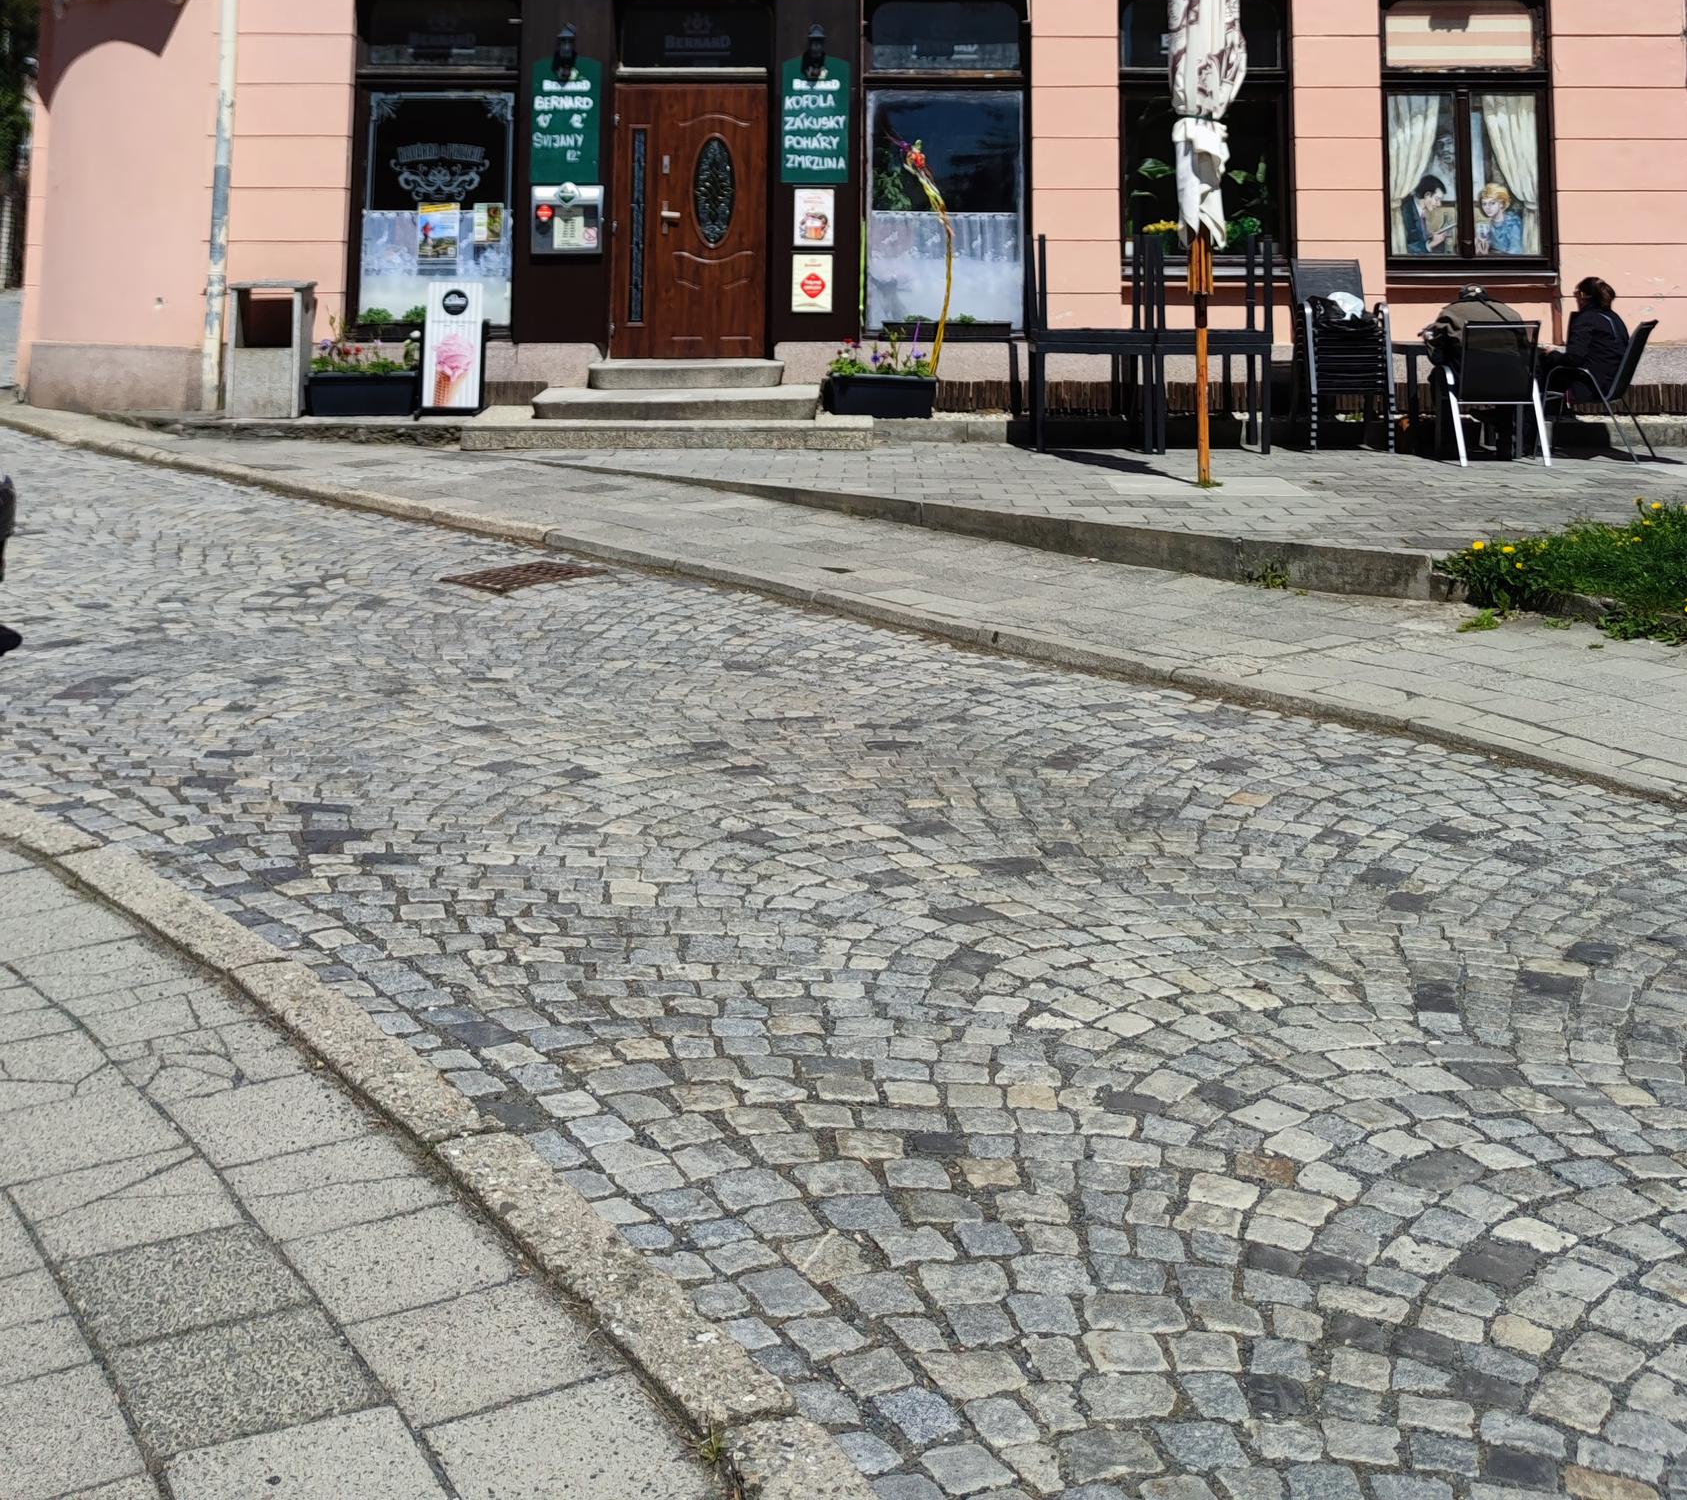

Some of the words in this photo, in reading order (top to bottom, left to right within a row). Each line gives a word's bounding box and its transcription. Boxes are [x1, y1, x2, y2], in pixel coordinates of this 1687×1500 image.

[533, 95, 593, 111] BERNARD
[784, 93, 835, 110] KOFOLA
[784, 111, 846, 131] ZÁKUSKY
[784, 132, 840, 150] POHÁRY
[785, 154, 846, 170] ZMRZLINA
